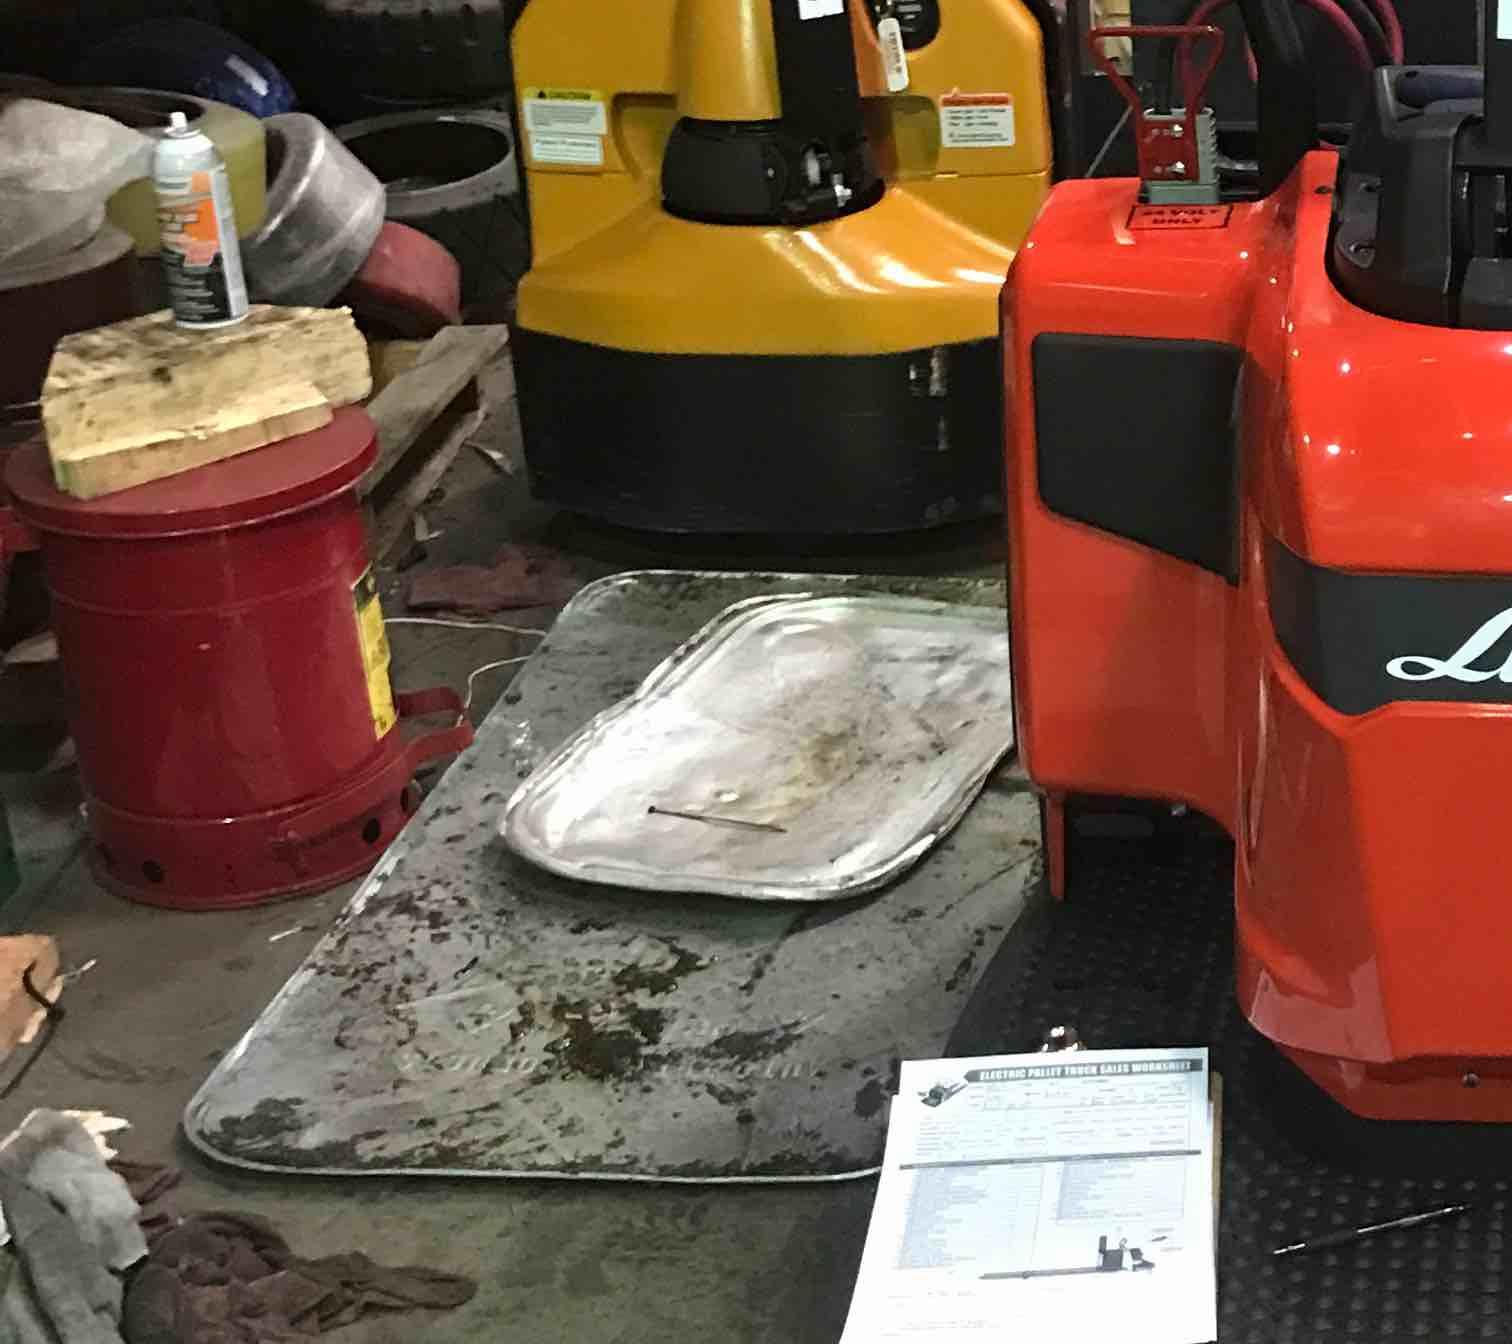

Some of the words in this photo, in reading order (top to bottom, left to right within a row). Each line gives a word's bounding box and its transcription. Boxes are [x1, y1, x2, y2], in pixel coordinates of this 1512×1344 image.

[980, 1067, 1026, 1080] ELECTRIC
[1028, 1066, 1062, 1078] PALLET
[1064, 1064, 1097, 1076] TRUCK
[1100, 1063, 1130, 1074] SALES
[1132, 1061, 1192, 1072] WORKSHEET
